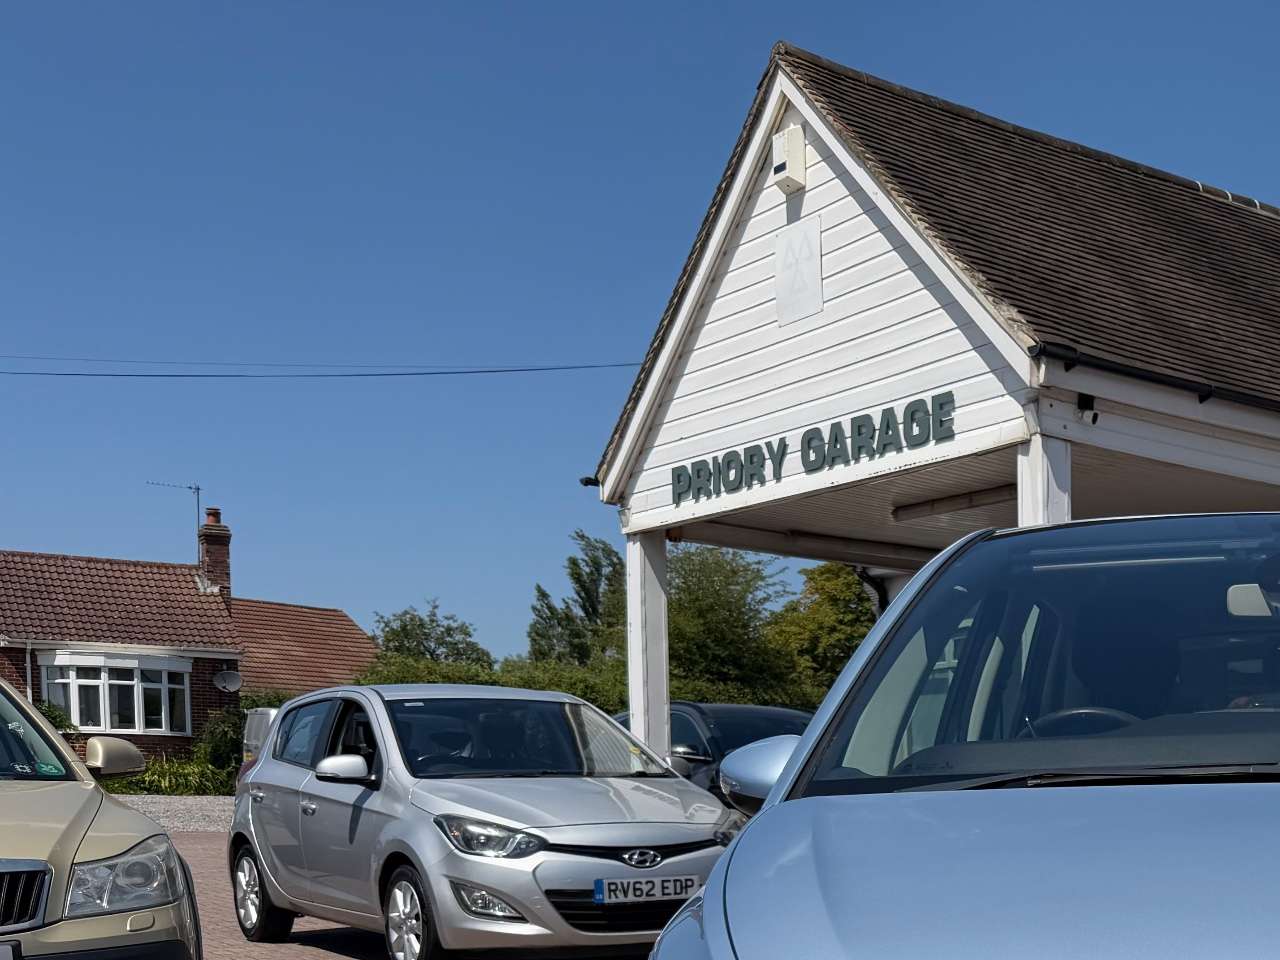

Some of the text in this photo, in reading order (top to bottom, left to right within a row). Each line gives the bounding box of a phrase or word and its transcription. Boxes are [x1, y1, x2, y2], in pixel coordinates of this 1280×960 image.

[672, 390, 956, 508] PRIORY GARAGE
[607, 878, 695, 900] RV62 EDP
